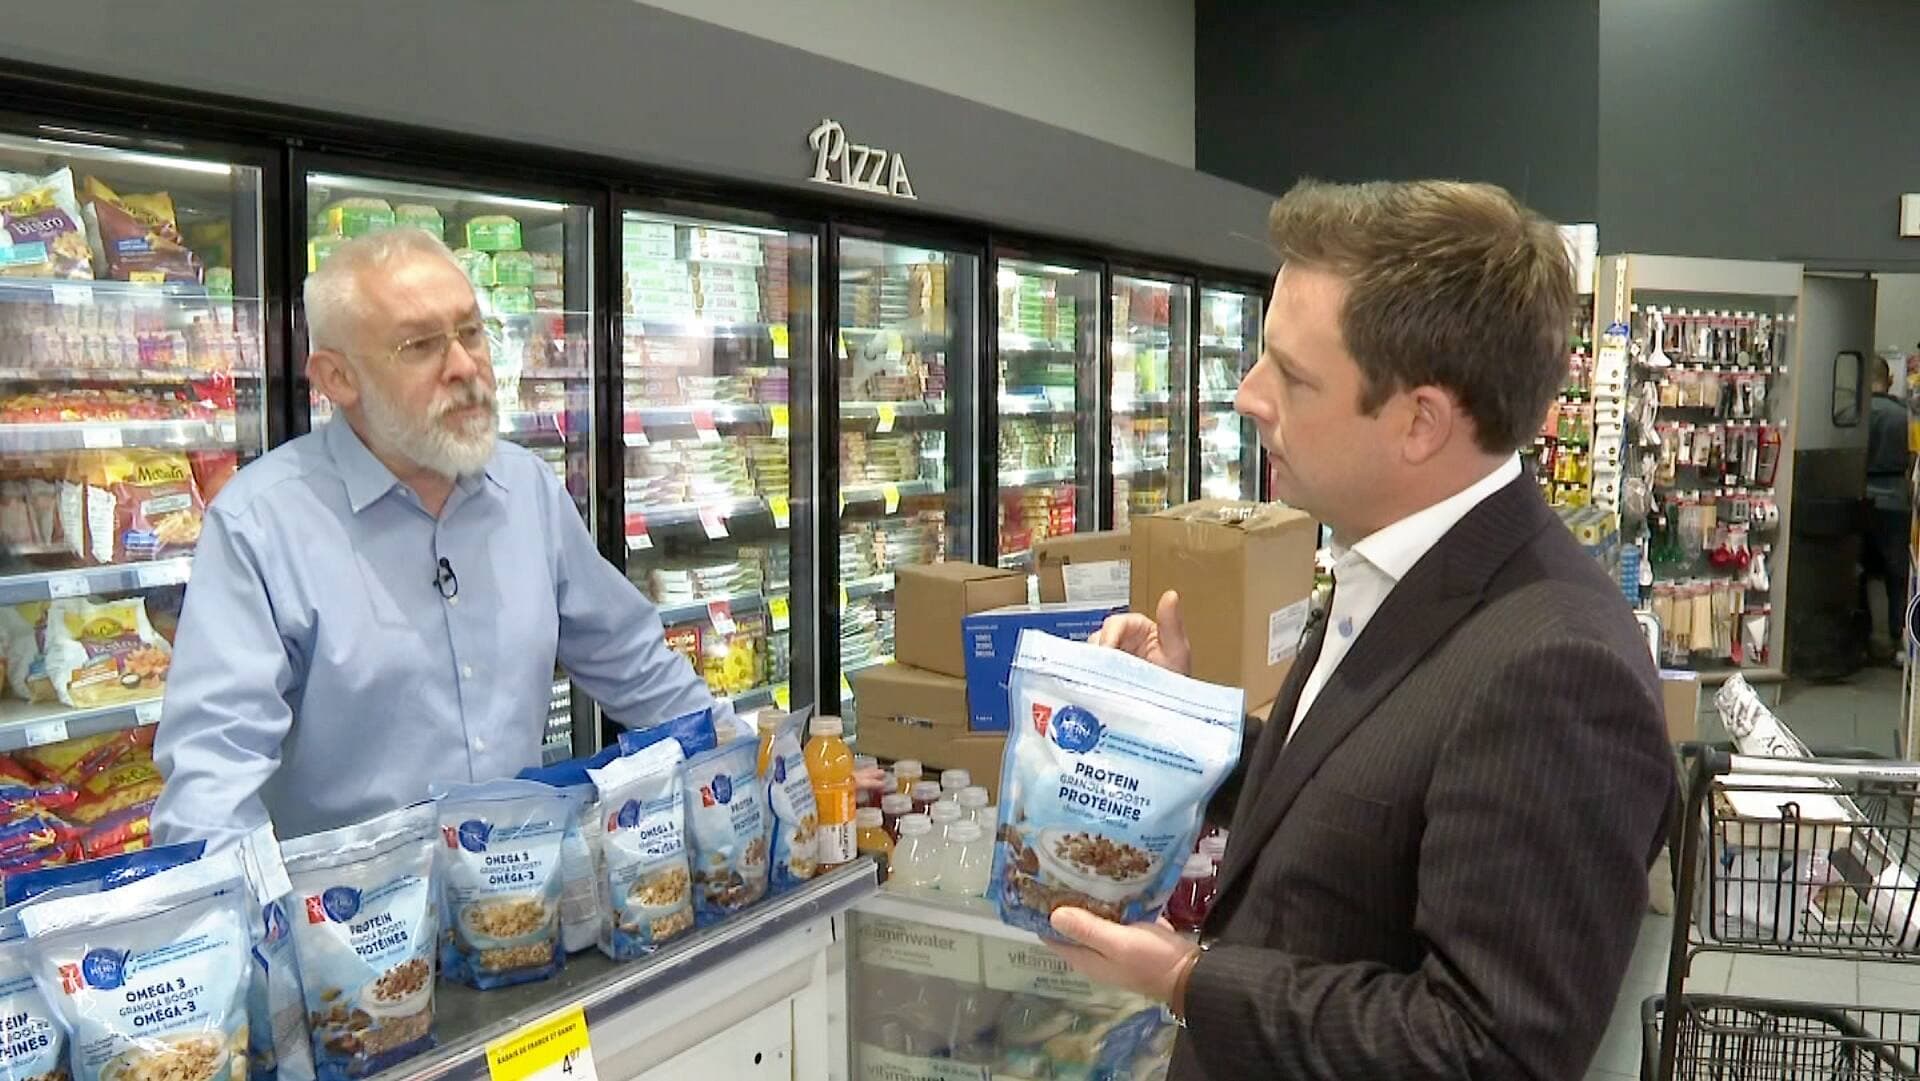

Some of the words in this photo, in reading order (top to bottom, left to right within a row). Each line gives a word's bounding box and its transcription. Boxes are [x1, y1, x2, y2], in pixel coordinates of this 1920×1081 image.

[808, 119, 918, 200] PIZZA
[1075, 762, 1139, 792] PROTEIN
[485, 853, 520, 866] OMEGA
[126, 981, 175, 1003] OMEGA
[176, 977, 186, 989] 3
